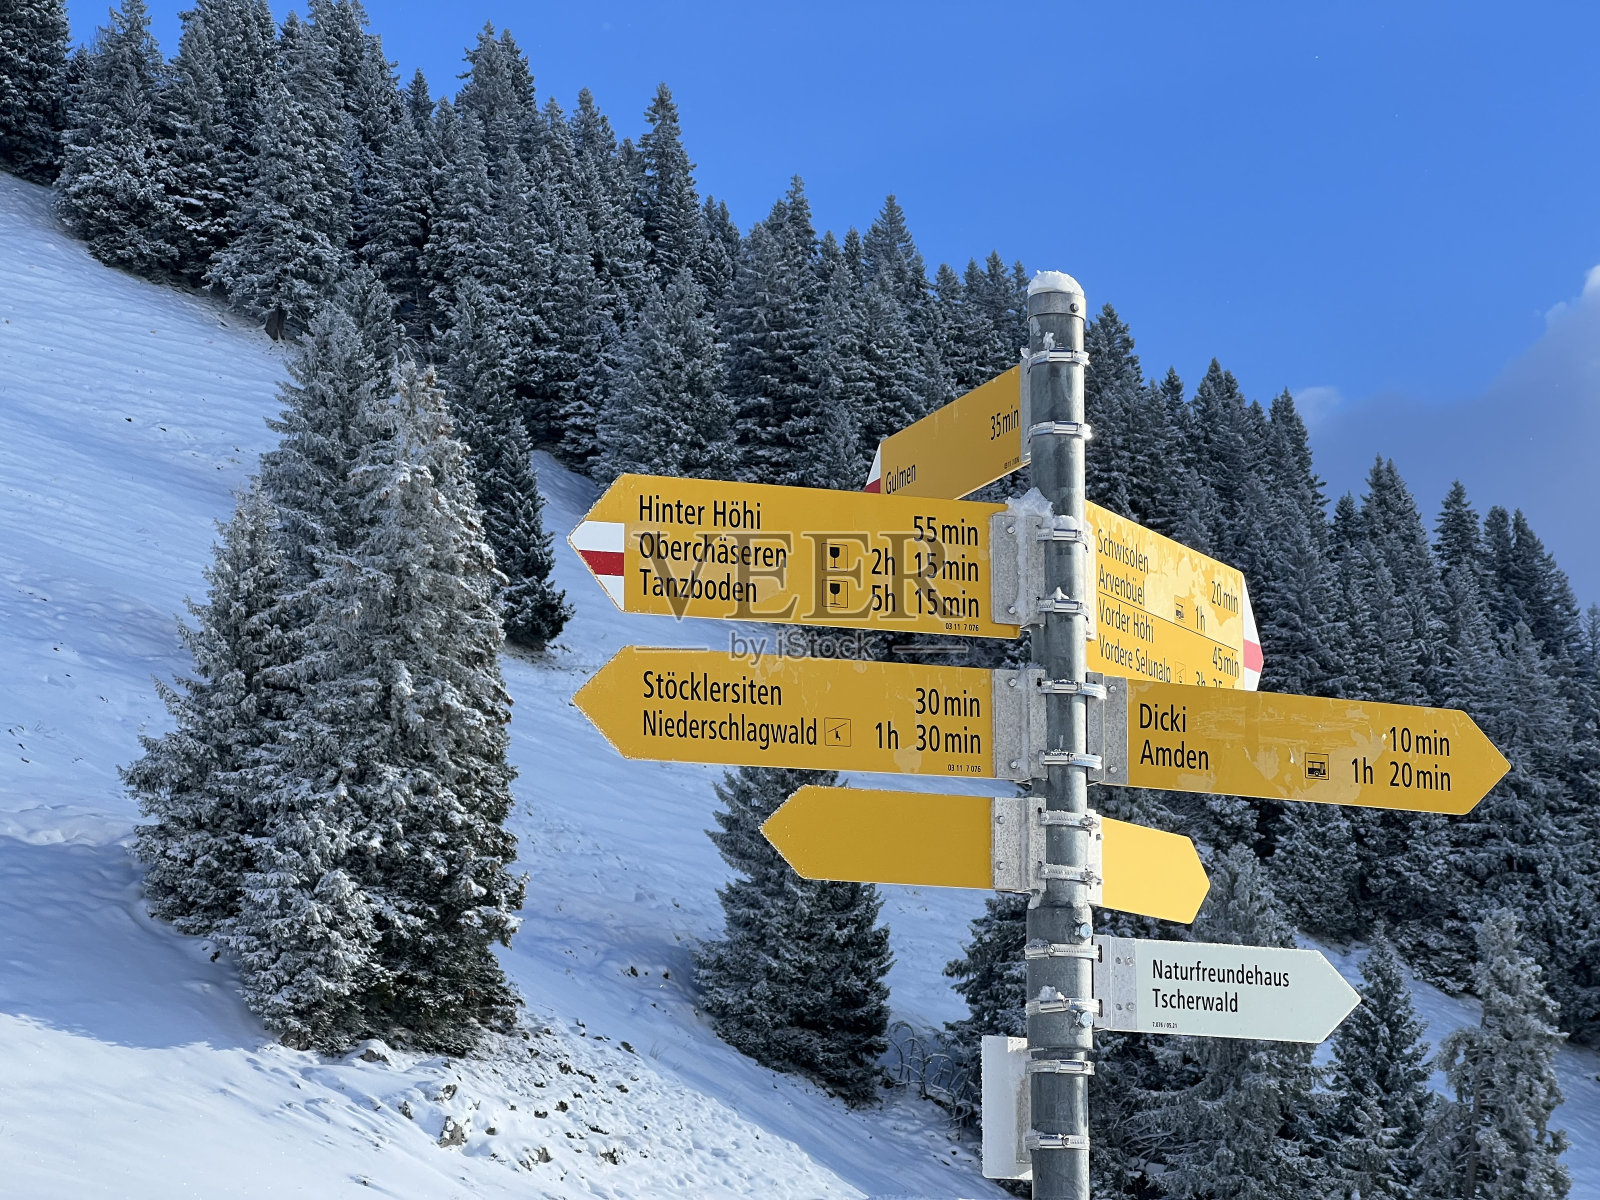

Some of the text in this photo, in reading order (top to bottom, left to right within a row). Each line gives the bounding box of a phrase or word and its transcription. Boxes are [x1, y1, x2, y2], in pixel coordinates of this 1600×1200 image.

[885, 464, 916, 494] Gulmen
[639, 495, 705, 525] Hinter
[713, 500, 761, 529] Höhi
[639, 531, 787, 568] Oberchäseren
[871, 547, 896, 576] 2h
[1097, 528, 1149, 574] Schwisolen
[639, 568, 757, 603] Tanzboden
[872, 584, 896, 612] 5h
[1098, 563, 1206, 633] Arvenbüel 1h
[1098, 597, 1131, 634] Vorder
[1133, 611, 1154, 644] Höhi
[1098, 632, 1133, 669] Vordere
[643, 670, 782, 706] Stöcklersiten
[643, 709, 818, 750] Niederschlagwald
[875, 720, 899, 750] 1h
[1138, 703, 1187, 733] Dicki
[1140, 739, 1209, 771] Amden
[1350, 757, 1374, 785] 1h
[1152, 959, 1290, 988] Naturfreundehaus
[1152, 988, 1239, 1013] Tscherwald
